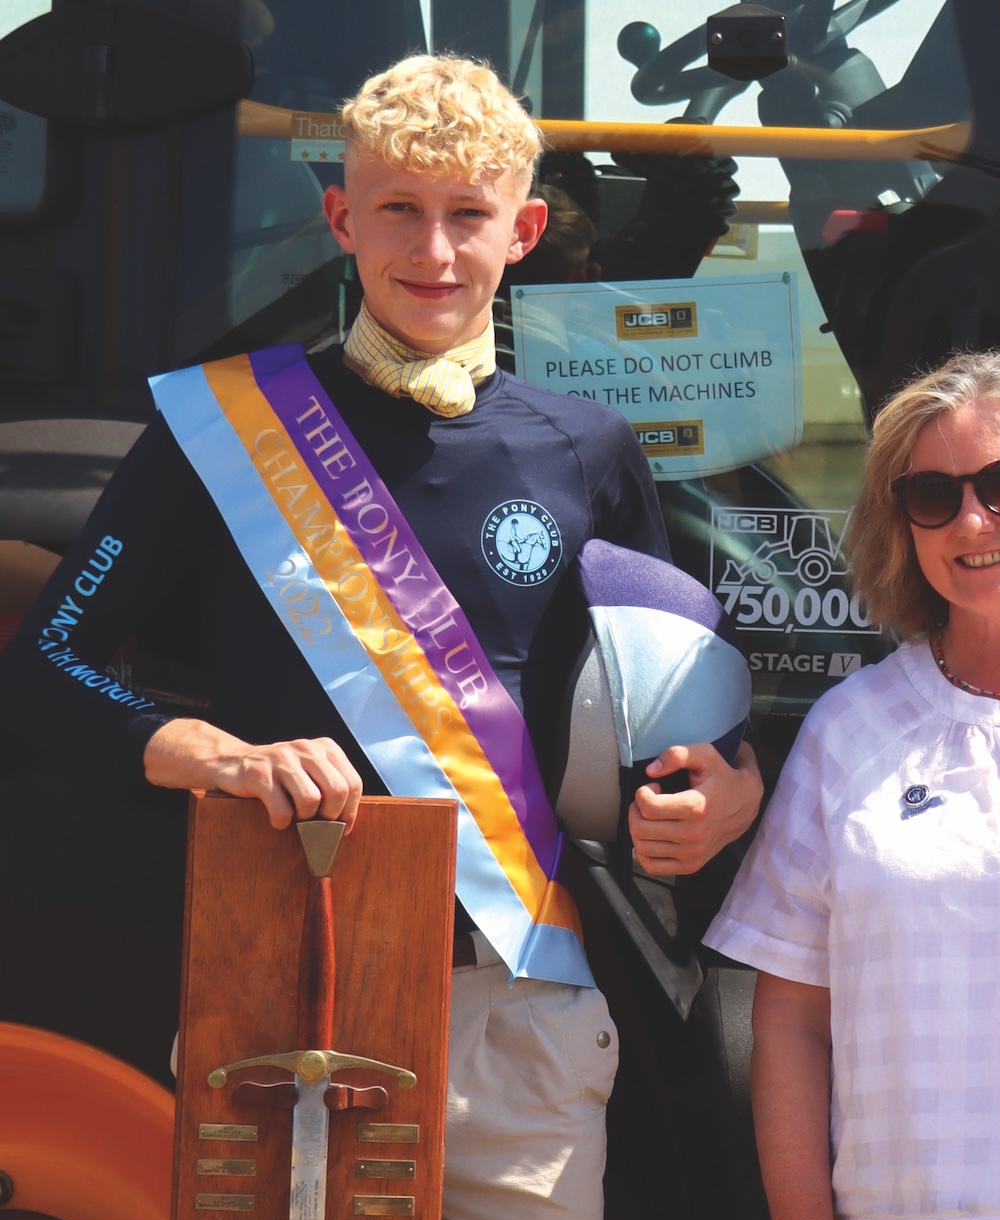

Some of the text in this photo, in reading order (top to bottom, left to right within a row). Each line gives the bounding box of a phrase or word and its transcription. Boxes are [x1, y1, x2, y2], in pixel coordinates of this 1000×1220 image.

[625, 312, 667, 326] JCB
[546, 350, 773, 378] PLEASE DO NOT CLIMB
[603, 387, 641, 405] THE
[649, 381, 756, 402] MACHINES
[486, 503, 559, 547] THE PONY CLUB
[719, 515, 776, 532] JCB
[74, 535, 124, 597] CLUB
[295, 395, 489, 710] THE PONY CLUB
[254, 428, 454, 735] CHAMPIONSHIPS
[495, 562, 548, 583] EST 1929
[266, 558, 333, 646] 2022
[715, 585, 873, 633] 750,000
[749, 652, 855, 673] STAGE V
